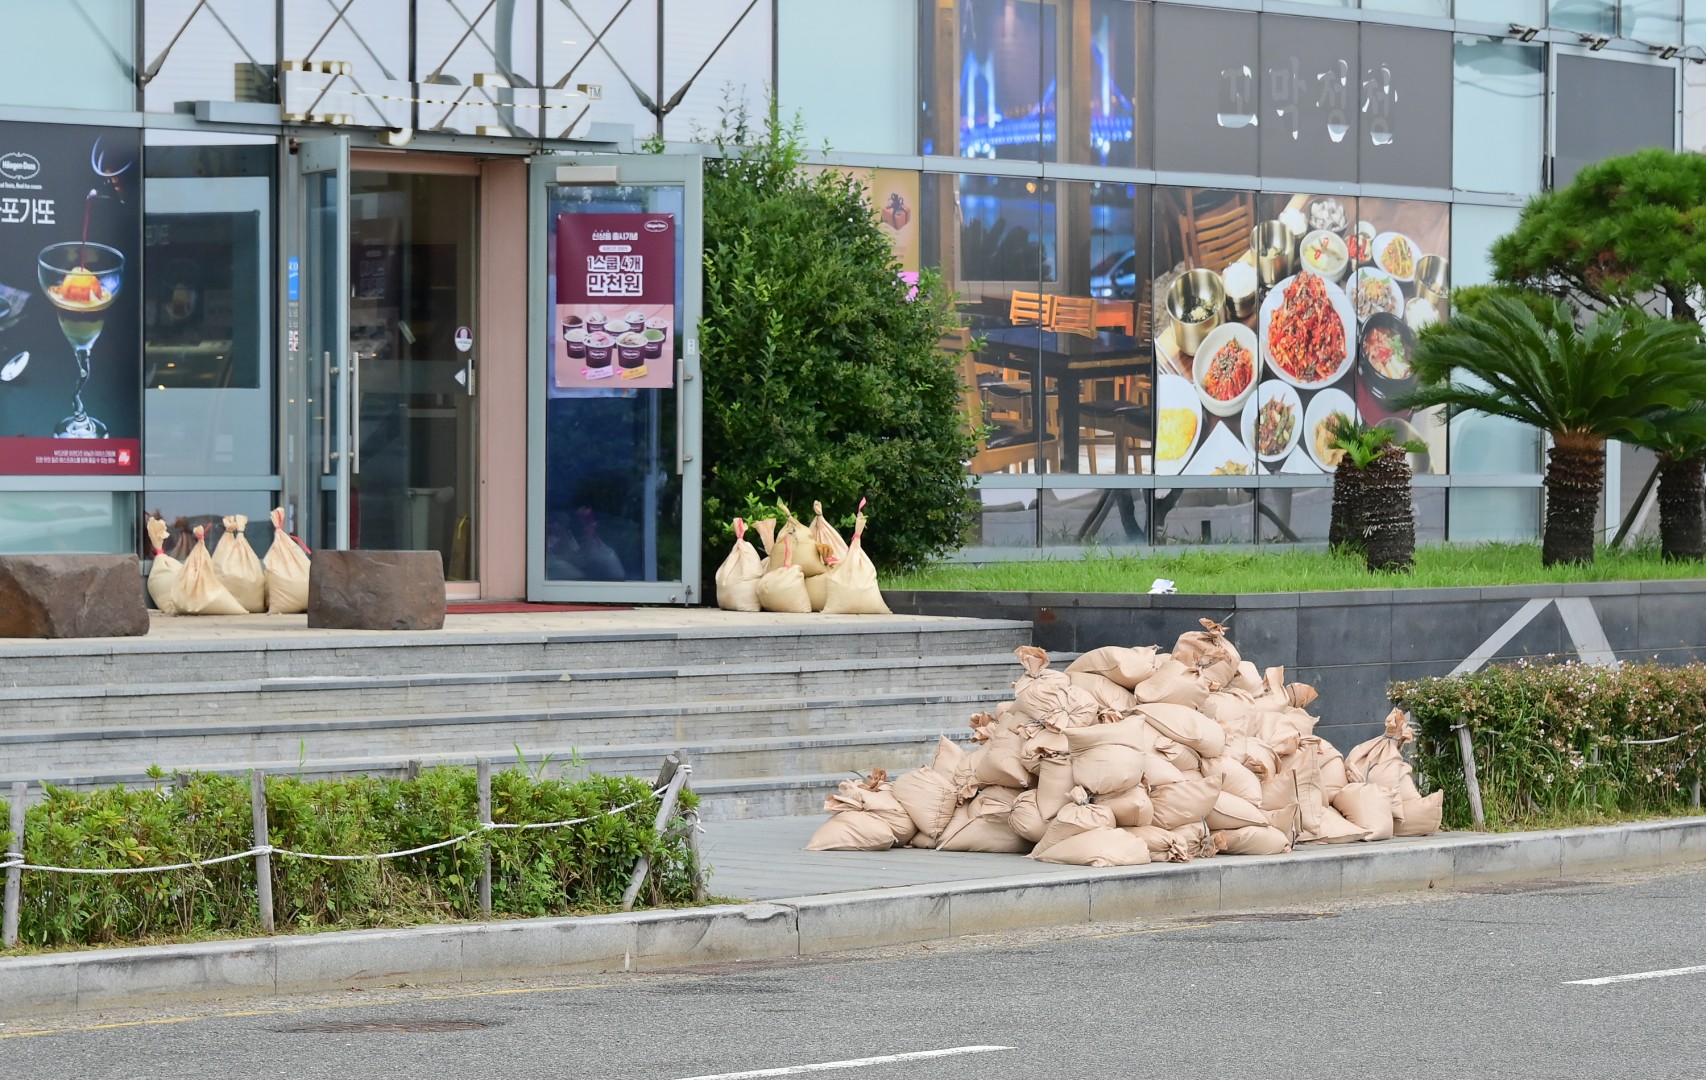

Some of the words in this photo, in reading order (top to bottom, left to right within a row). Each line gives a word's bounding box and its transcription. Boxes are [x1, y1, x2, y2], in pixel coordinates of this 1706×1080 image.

[0, 197, 56, 225] 포가또
[621, 256, 643, 271] 4개
[587, 274, 643, 296] 만천원
